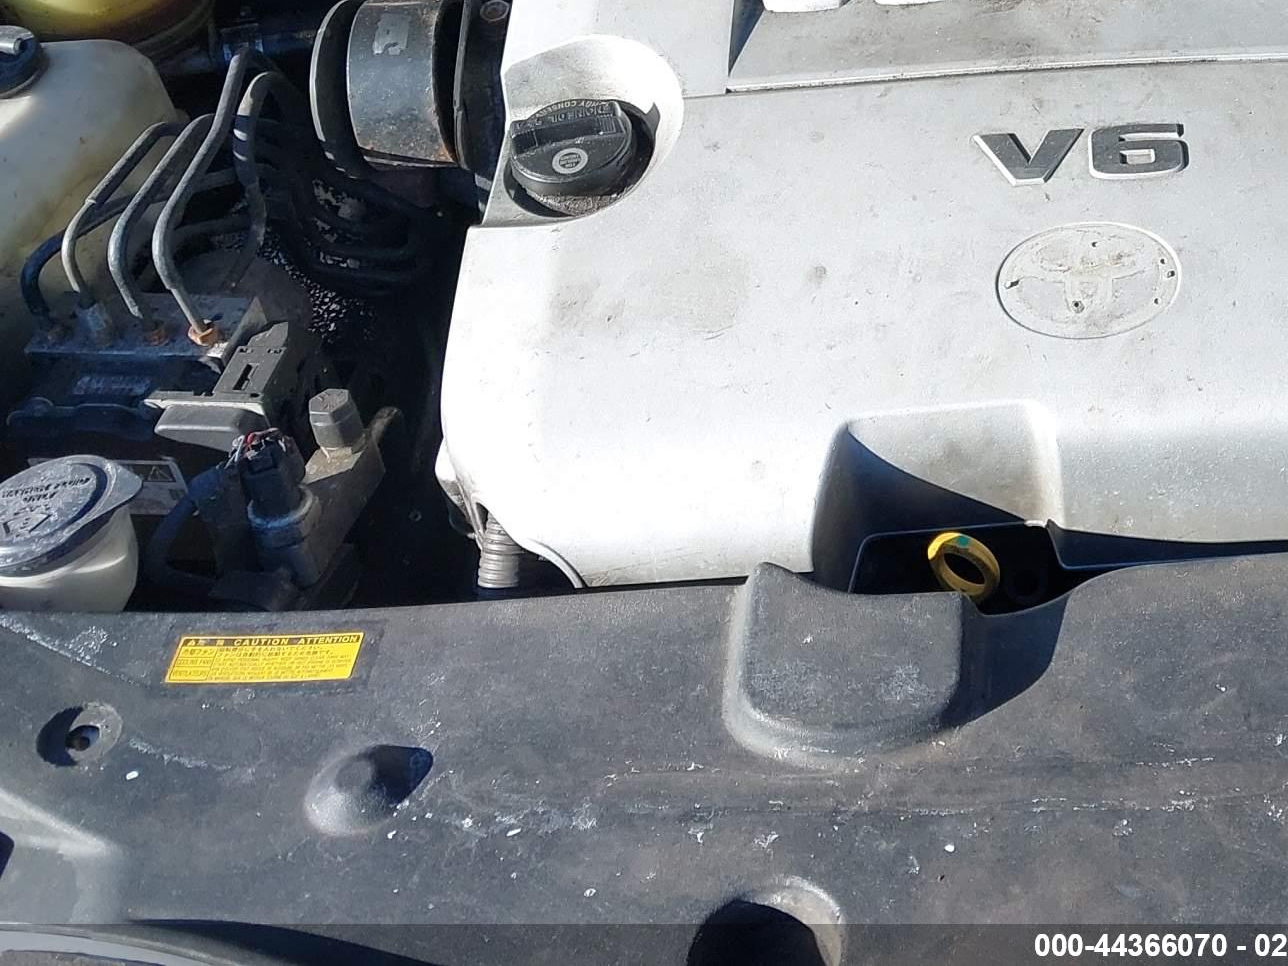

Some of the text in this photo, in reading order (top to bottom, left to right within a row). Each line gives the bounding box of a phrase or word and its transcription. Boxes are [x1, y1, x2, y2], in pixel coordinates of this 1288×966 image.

[971, 122, 1190, 187] V6
[233, 638, 290, 647] CAUTION
[297, 634, 359, 645] ATTENTION
